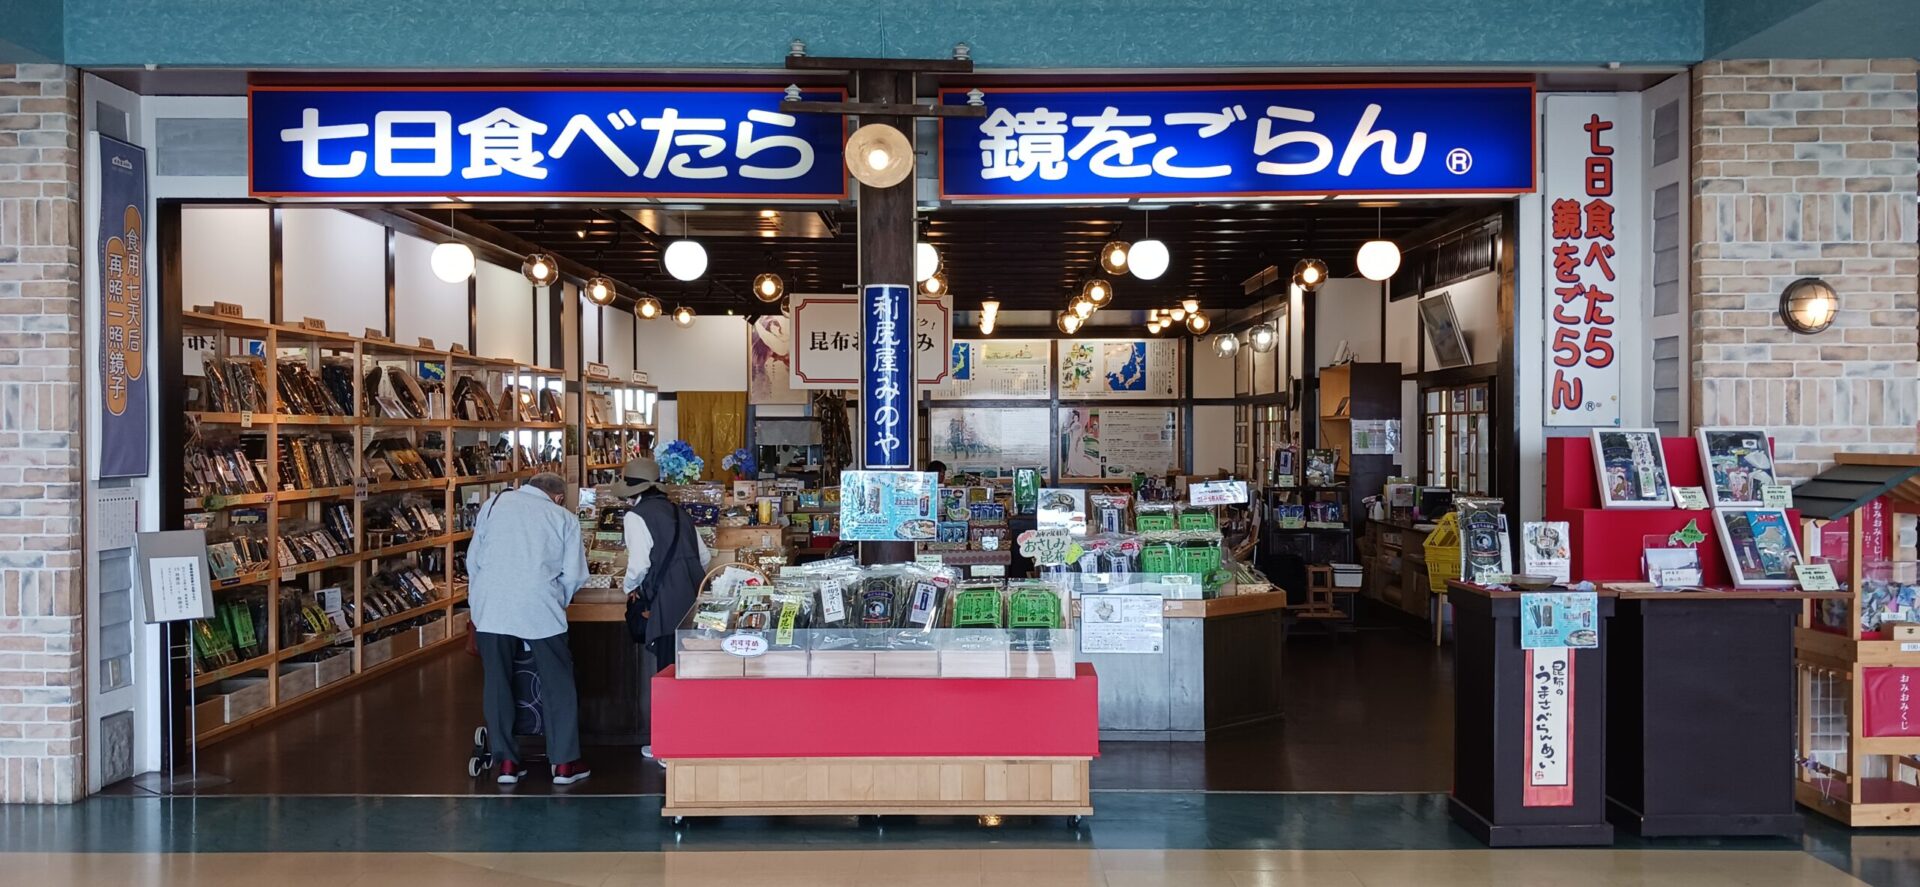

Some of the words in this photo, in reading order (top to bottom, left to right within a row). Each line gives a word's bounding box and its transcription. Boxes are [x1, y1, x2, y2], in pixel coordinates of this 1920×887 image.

[280, 107, 815, 181] 七日食べたら
[979, 103, 1428, 181] 鏡をごらん
[1583, 113, 1616, 369] 七日食べたら
[107, 253, 126, 400] 再照一照鏡子
[125, 228, 142, 353] 食用七天后
[1551, 198, 1585, 410] 鏡をごらん
[872, 295, 901, 457] 利尻屋みのや
[1024, 537, 1067, 553] おさしみ
[1040, 549, 1065, 564] 昆布
[1872, 501, 1883, 554] おみおみくじ
[730, 639, 760, 647] おすすめ
[1552, 659, 1567, 696] 昆布の
[1534, 664, 1556, 769] うまさべらんめい
[1899, 673, 1910, 731] おみおみくじ
